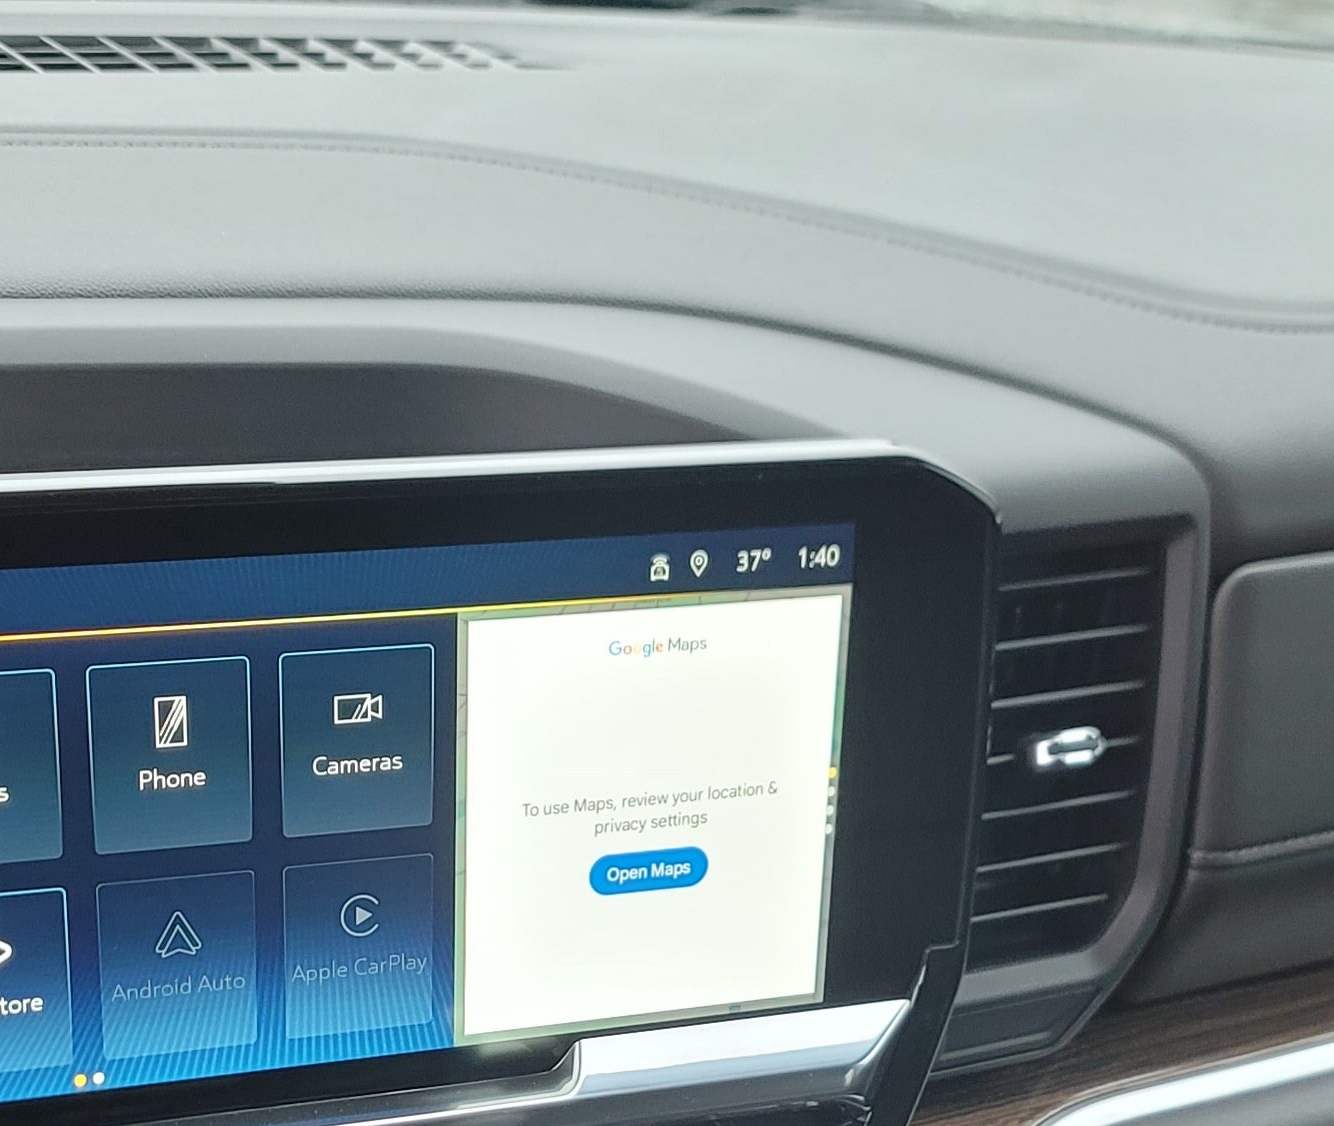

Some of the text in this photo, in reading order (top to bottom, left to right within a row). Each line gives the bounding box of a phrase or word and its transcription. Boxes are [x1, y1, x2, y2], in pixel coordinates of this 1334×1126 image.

[798, 544, 841, 569] 1:40
[608, 636, 707, 658] Google Maps
[312, 753, 404, 777] Cameras
[138, 768, 207, 791] Phone
[522, 781, 778, 817] To use Maps, review your location &
[594, 811, 708, 837] privacy settings
[606, 861, 692, 885] Open Maps
[291, 953, 428, 984] Apple CarPlay
[111, 974, 246, 1002] Android Auto
